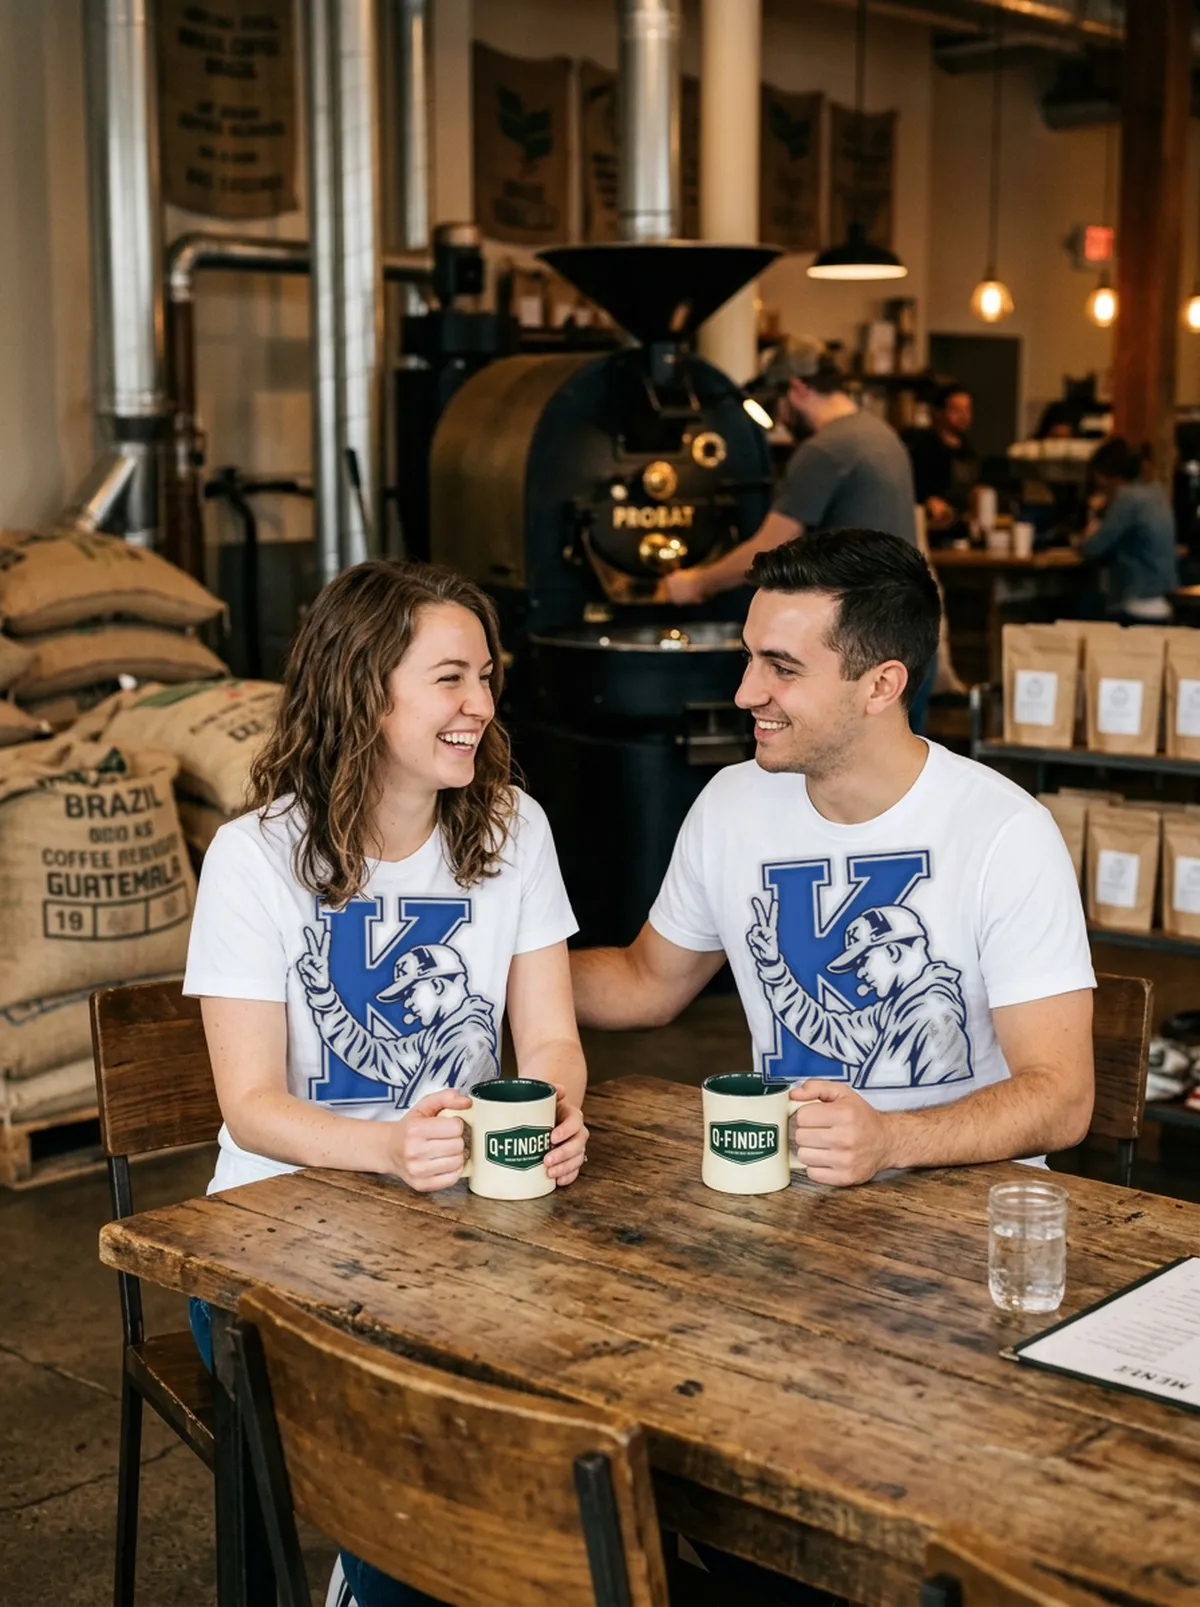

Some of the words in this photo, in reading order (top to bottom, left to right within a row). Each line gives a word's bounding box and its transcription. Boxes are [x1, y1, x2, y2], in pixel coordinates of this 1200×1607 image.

[65, 785, 163, 818] BRAZIL
[42, 849, 112, 869] COFFEE
[56, 910, 83, 932] 19
[846, 926, 860, 946] K
[395, 960, 408, 979] K
